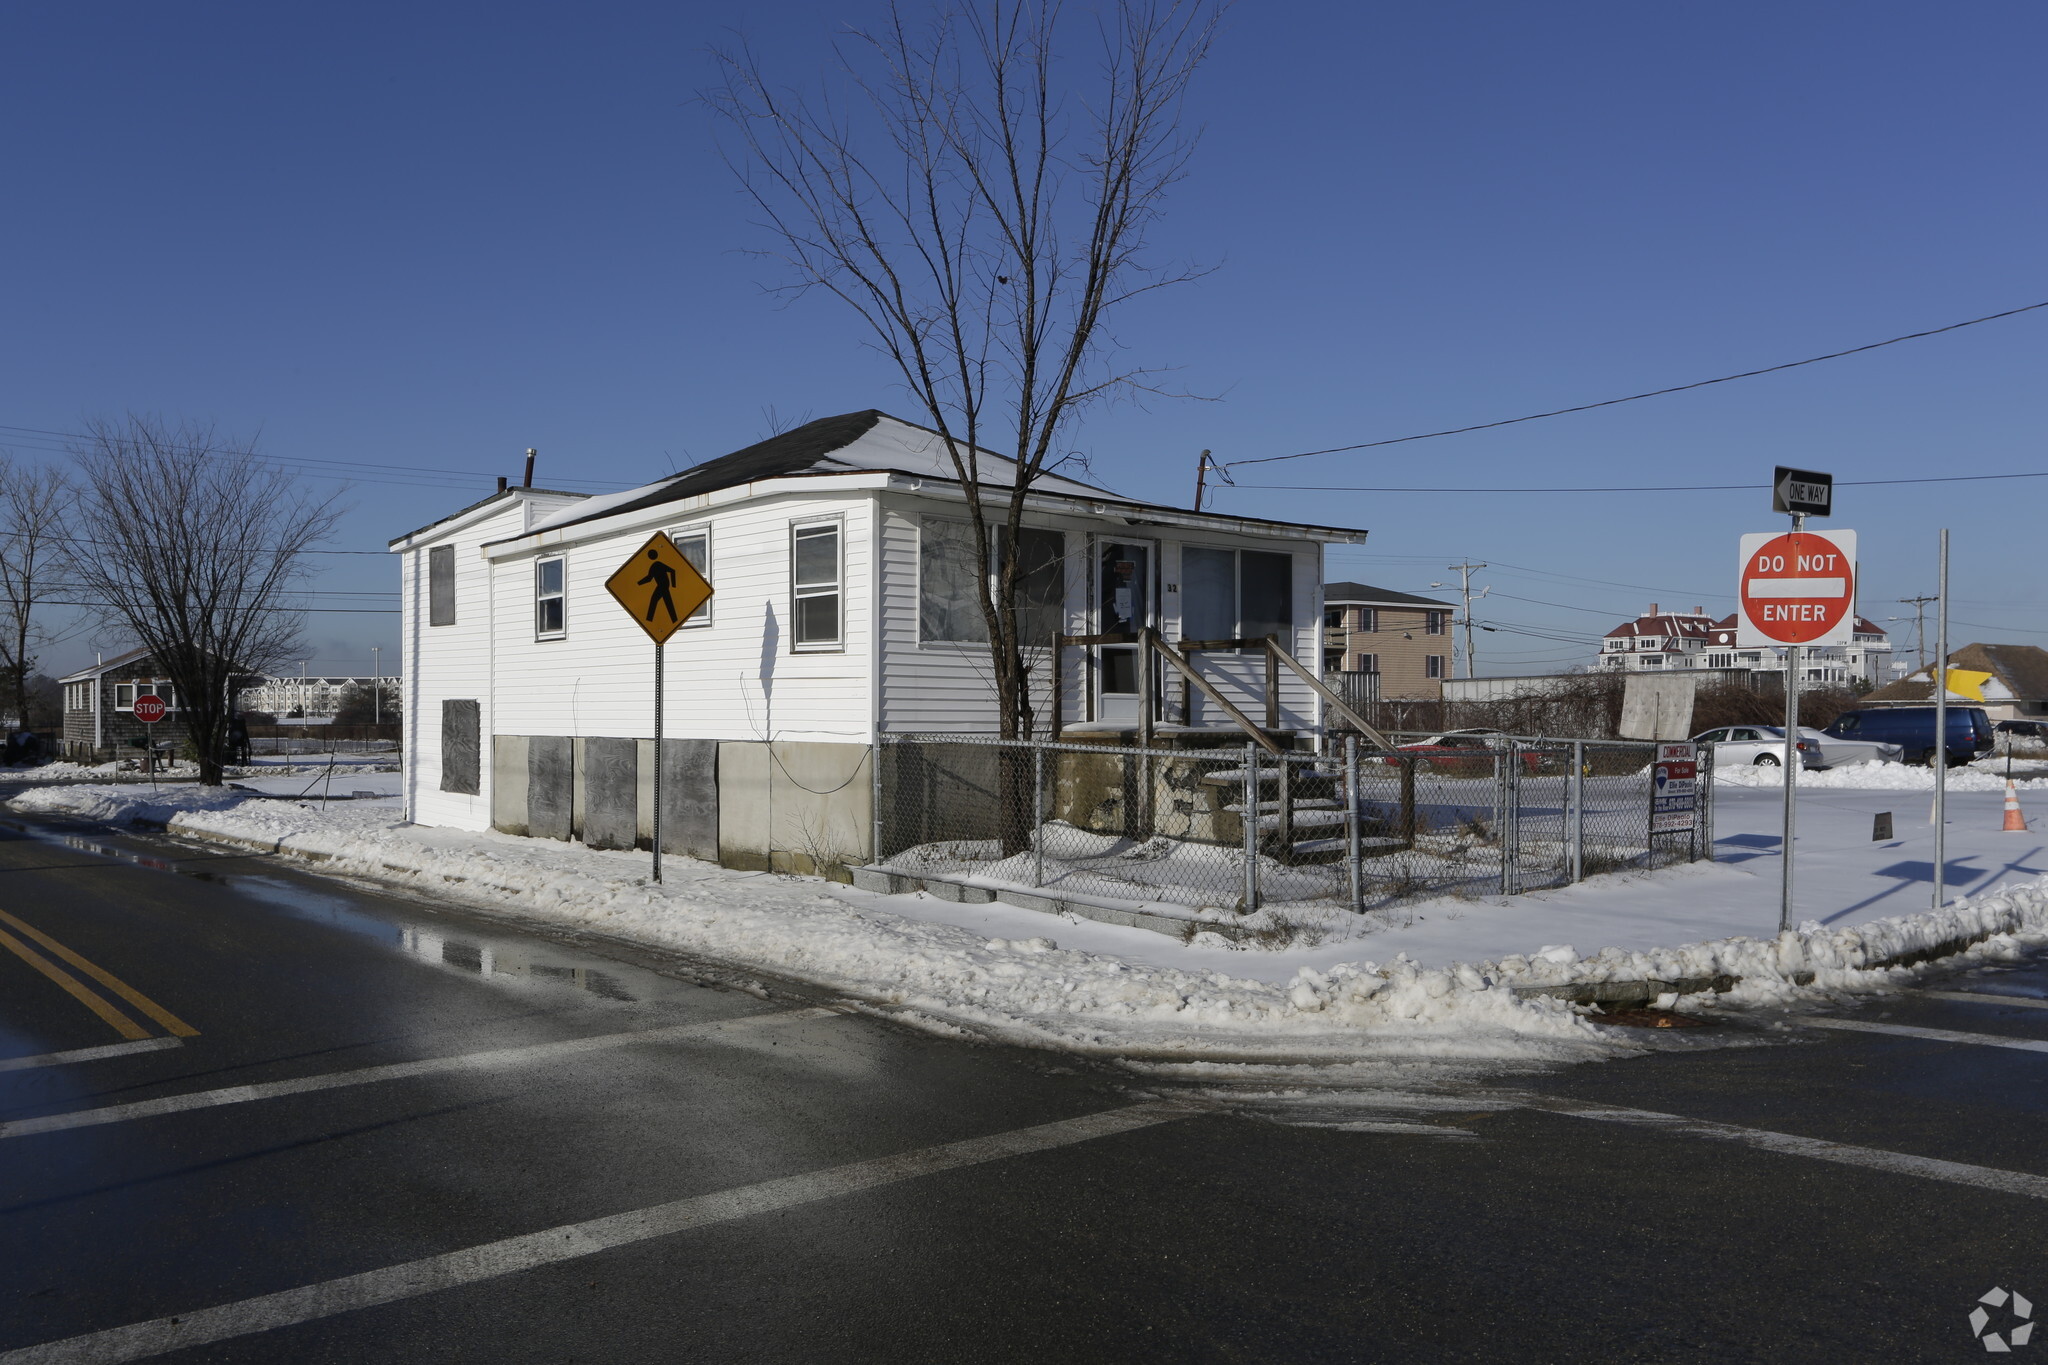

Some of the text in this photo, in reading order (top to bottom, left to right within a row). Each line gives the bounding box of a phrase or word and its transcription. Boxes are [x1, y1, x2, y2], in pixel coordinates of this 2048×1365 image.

[1790, 482, 1825, 502] ONE WAY
[1758, 554, 1837, 573] DO NOT
[1167, 584, 1177, 592] 32
[1763, 604, 1826, 622] ENTER
[136, 703, 164, 714] STOP
[1663, 745, 1691, 758] COMMERCIAL
